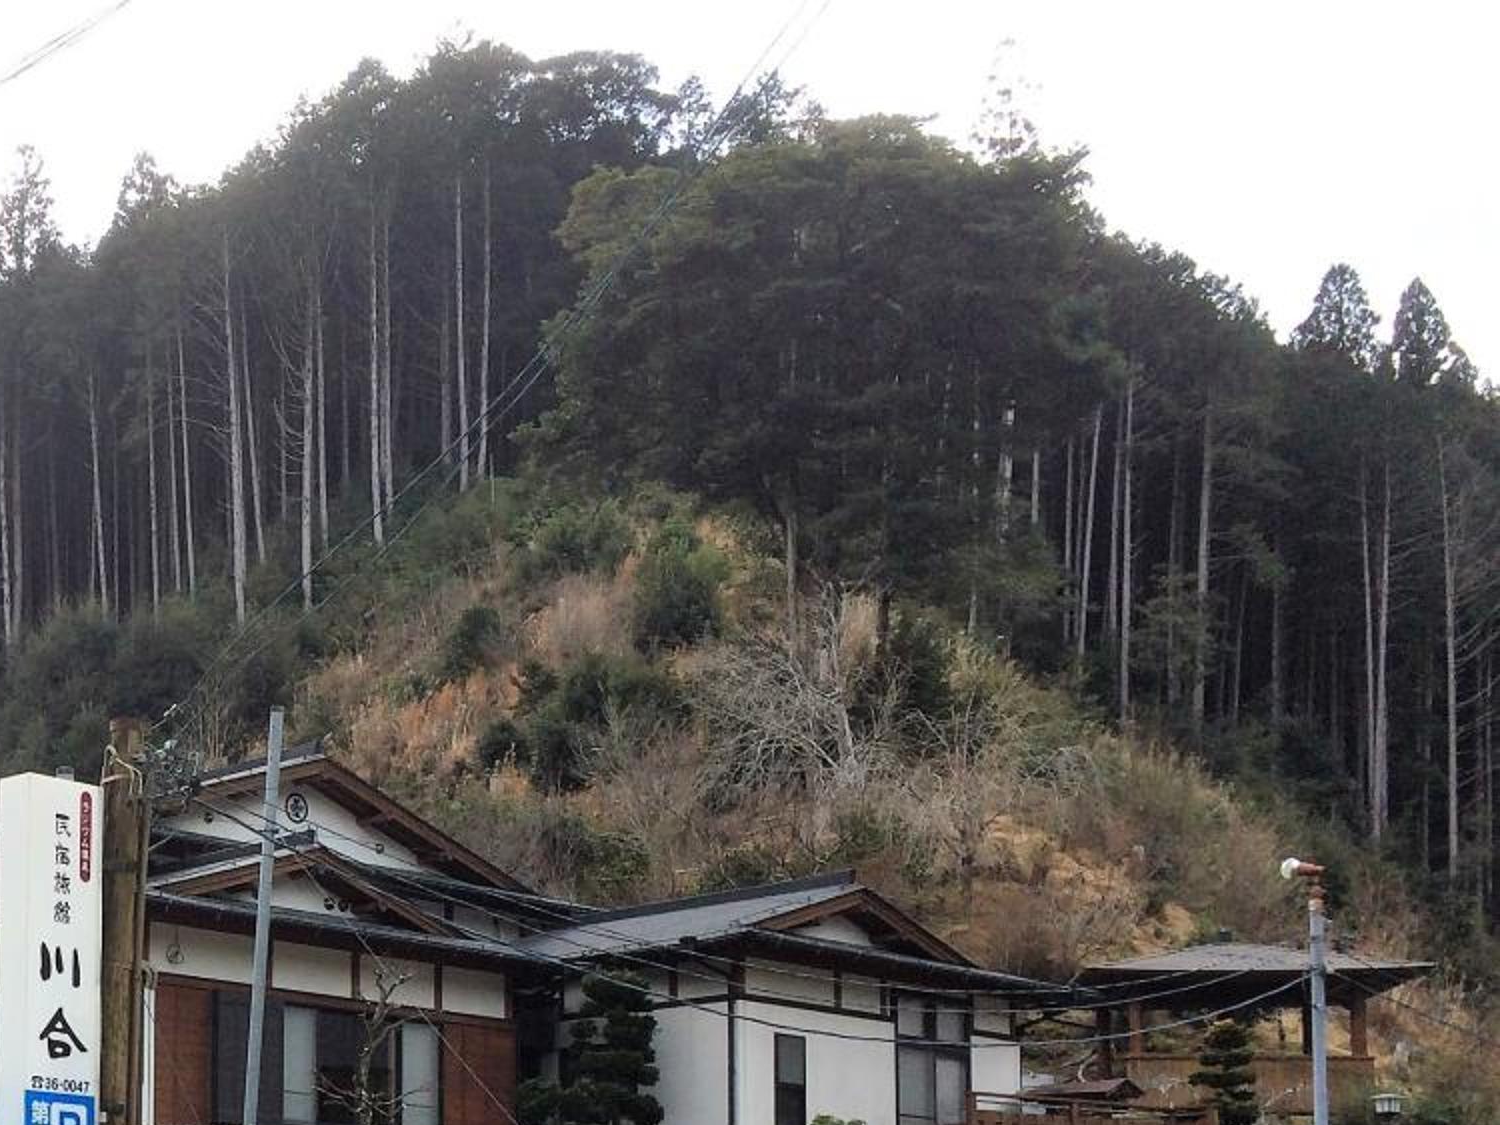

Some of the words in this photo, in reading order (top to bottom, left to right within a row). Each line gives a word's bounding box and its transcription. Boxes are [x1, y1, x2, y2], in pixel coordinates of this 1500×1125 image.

[53, 813, 71, 924] 民宿旅館
[39, 941, 88, 1059] 川合
